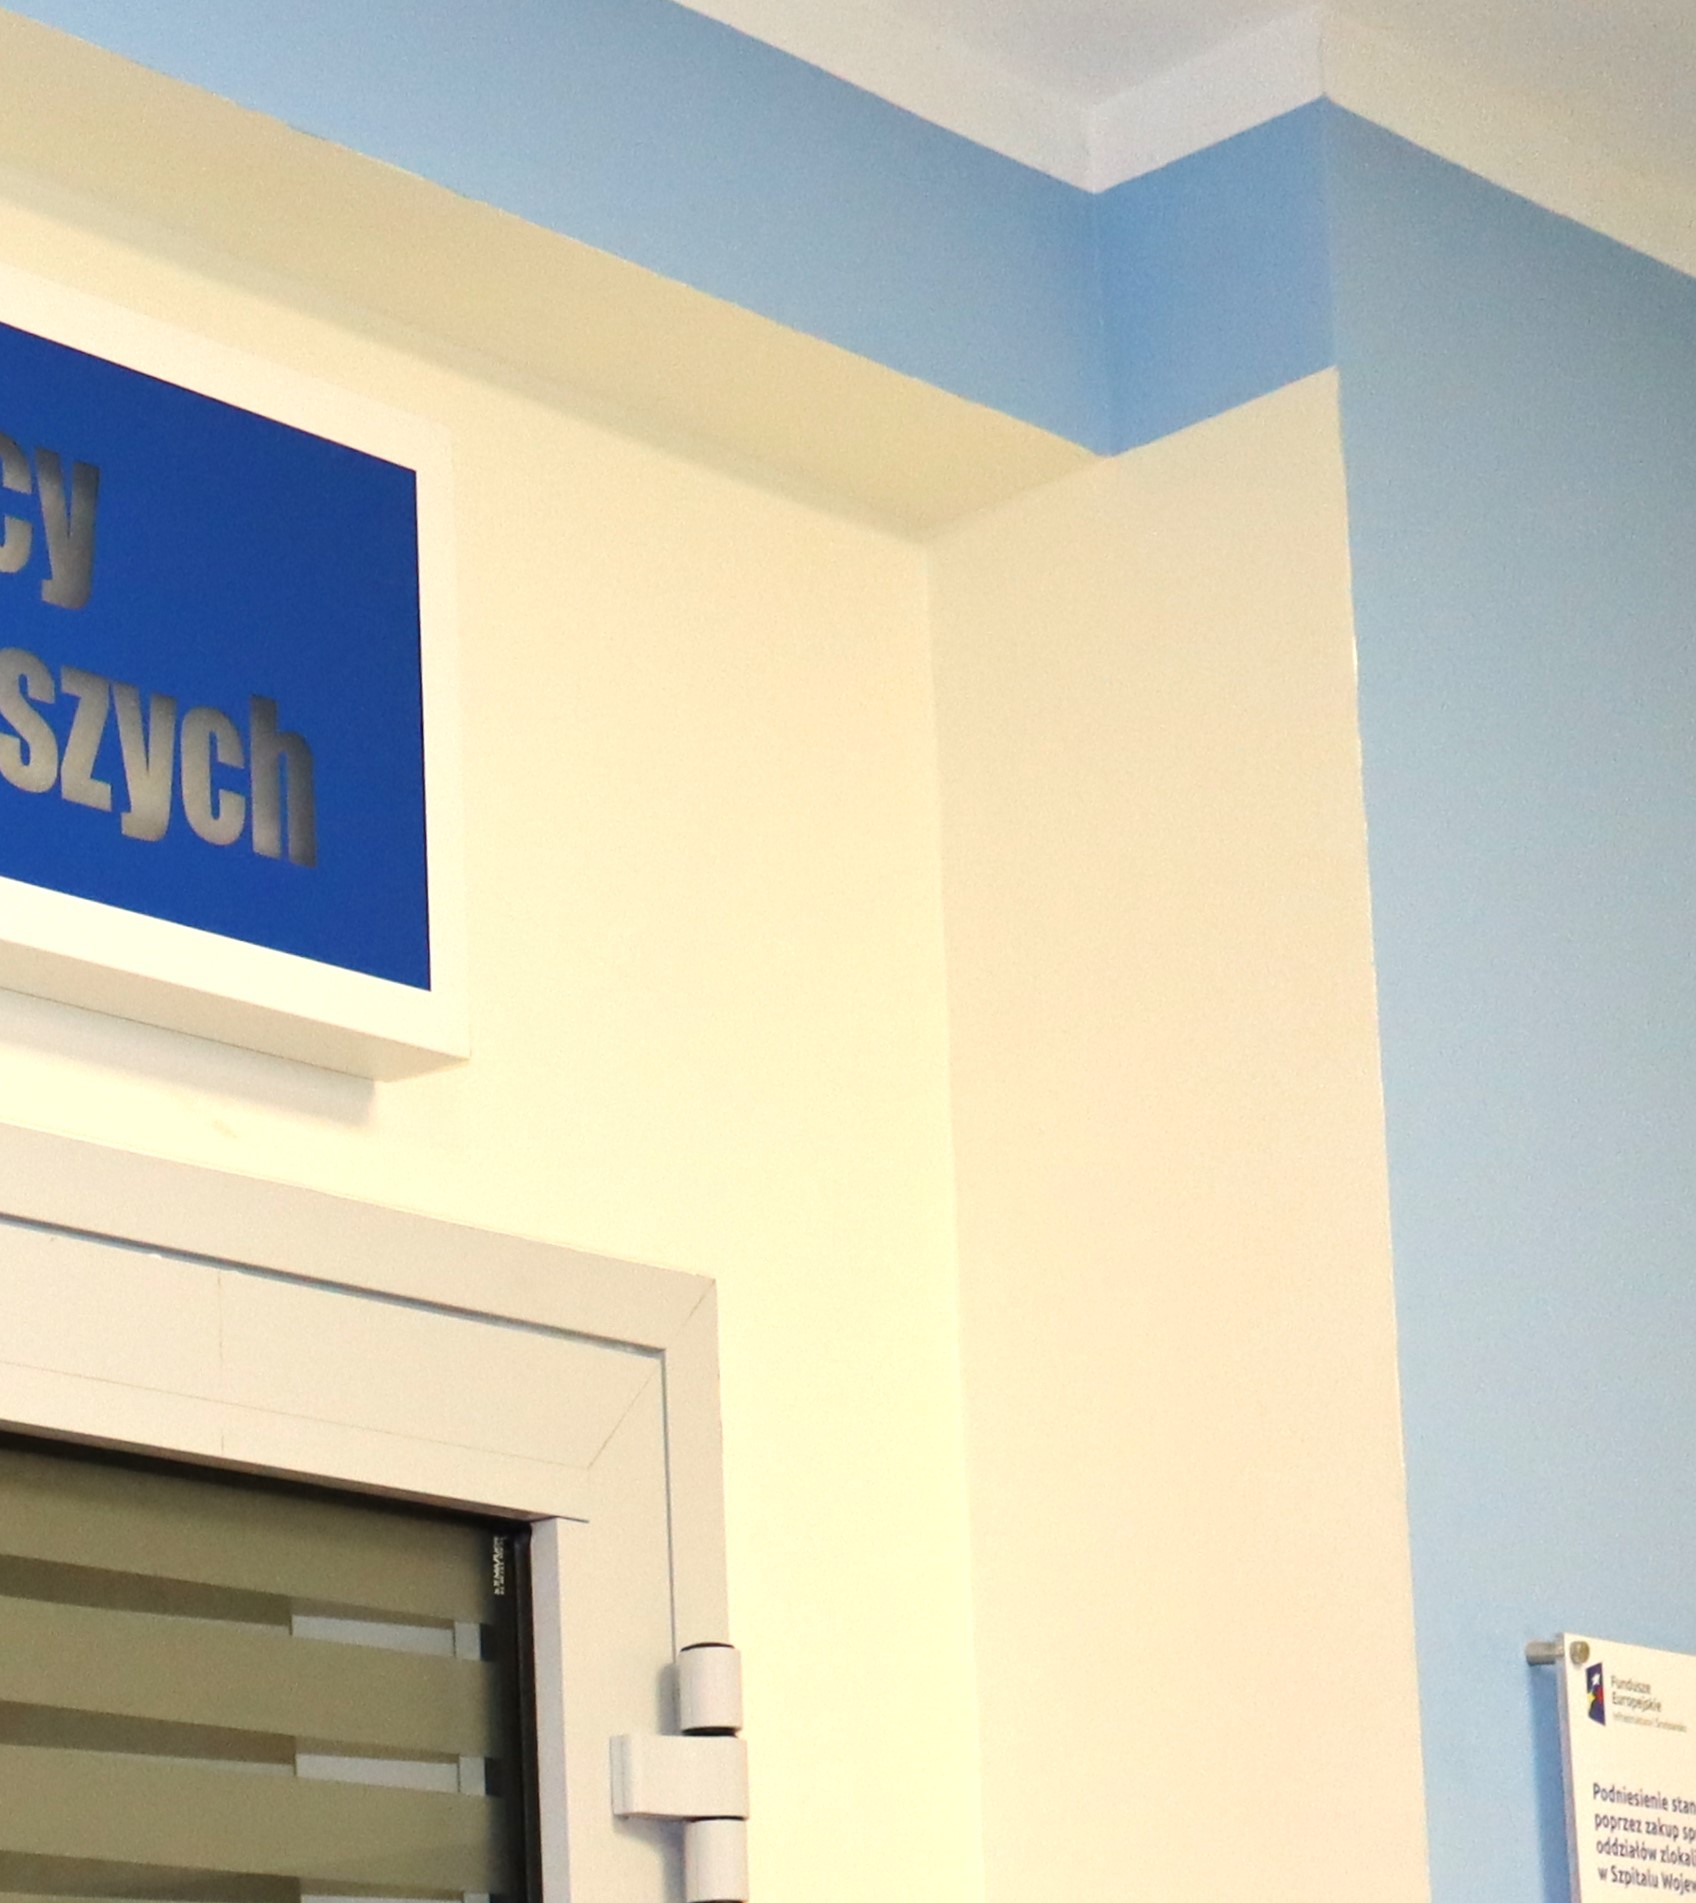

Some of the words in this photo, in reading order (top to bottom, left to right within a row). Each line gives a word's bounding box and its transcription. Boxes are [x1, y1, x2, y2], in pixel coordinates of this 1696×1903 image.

[1593, 1782, 1668, 1811] Podniesienie
[1595, 1813, 1642, 1833] poprzez
[1645, 1817, 1679, 1842] zakup
[1596, 1836, 1657, 1860] oddziałów
[1597, 1867, 1608, 1881] w
[1611, 1865, 1658, 1888] Szpitalu
